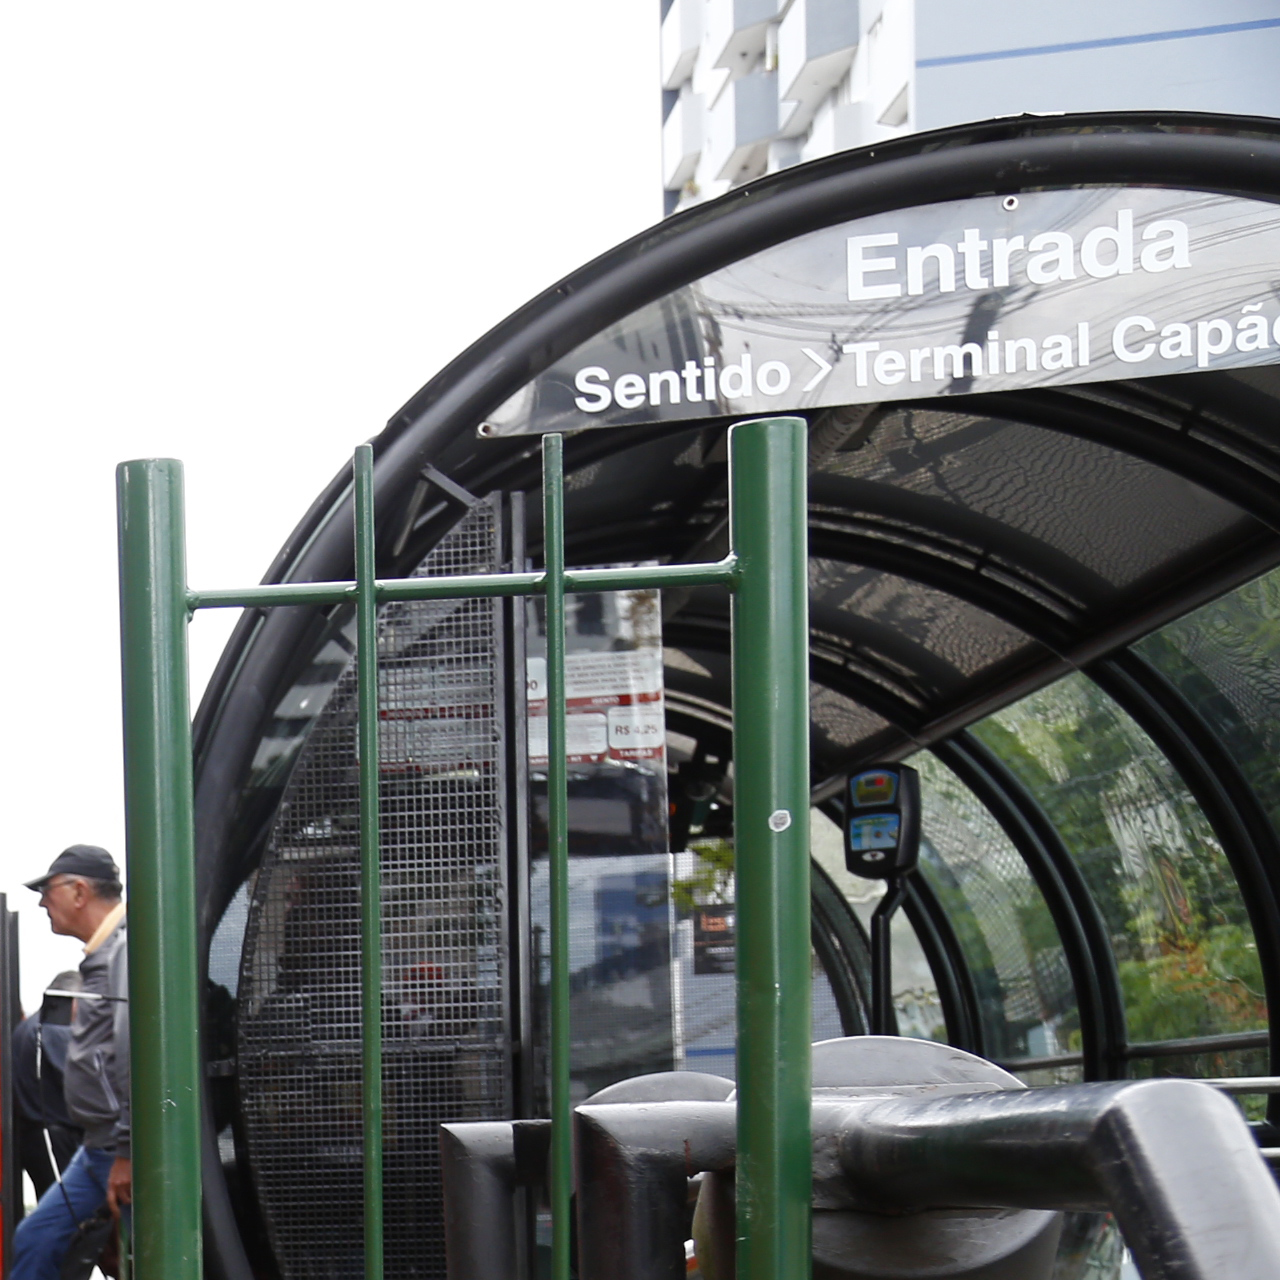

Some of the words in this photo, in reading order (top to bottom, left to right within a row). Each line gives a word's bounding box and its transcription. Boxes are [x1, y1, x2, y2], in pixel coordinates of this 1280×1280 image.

[845, 209, 1192, 302] Entrada
[574, 353, 791, 412] Sentido
[844, 322, 1090, 388] Terminal
